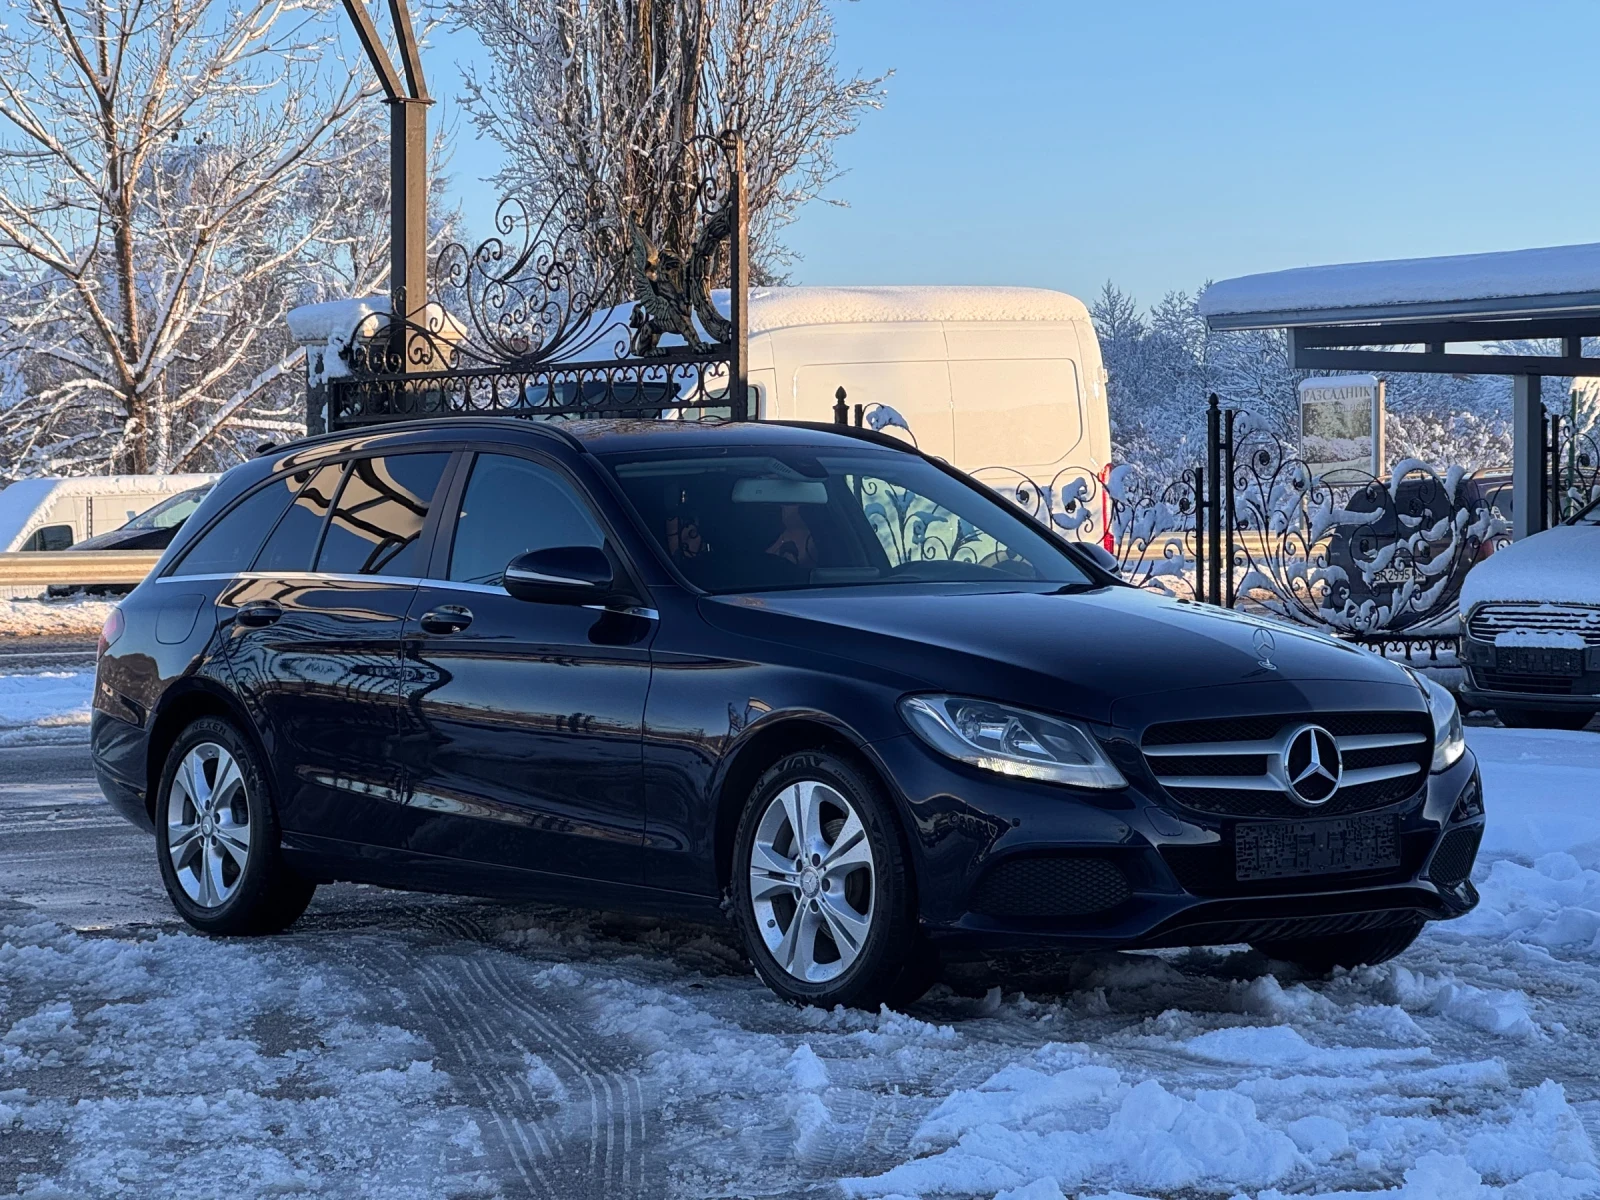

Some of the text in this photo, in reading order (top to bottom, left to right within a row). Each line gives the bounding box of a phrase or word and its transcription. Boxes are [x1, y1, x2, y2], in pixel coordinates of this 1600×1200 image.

[1303, 386, 1370, 402] РАЗСАДНИК
[1388, 569, 1410, 581] 2995
[193, 721, 227, 736] NEXEN
